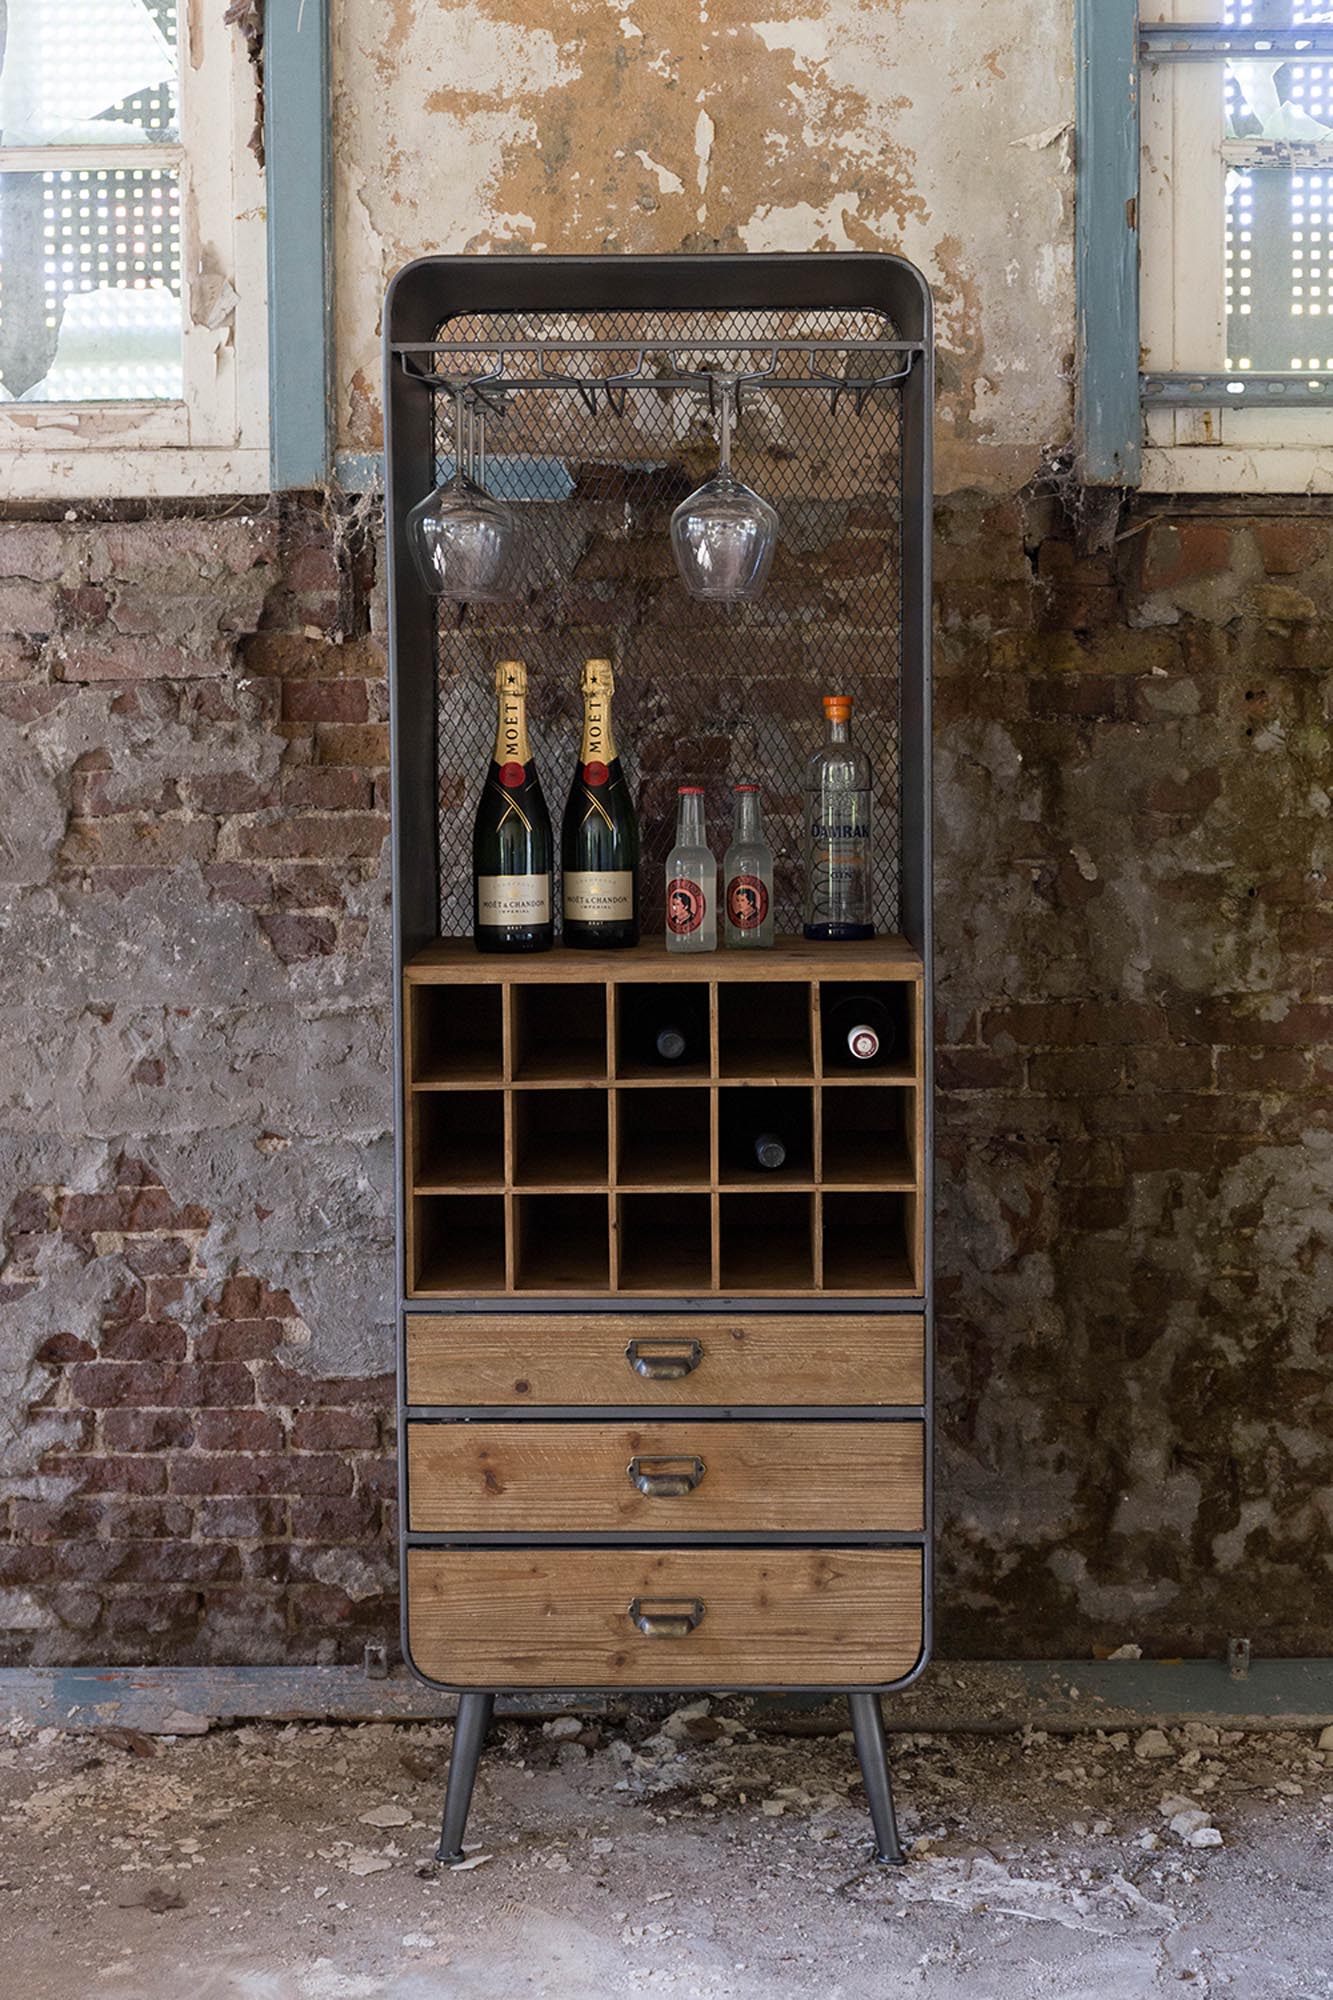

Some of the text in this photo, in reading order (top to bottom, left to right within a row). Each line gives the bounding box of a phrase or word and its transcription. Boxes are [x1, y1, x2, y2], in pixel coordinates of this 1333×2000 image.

[811, 824, 869, 838] DAMRAK
[508, 900, 545, 908] CHANDON
[591, 896, 628, 904] CHANDON
